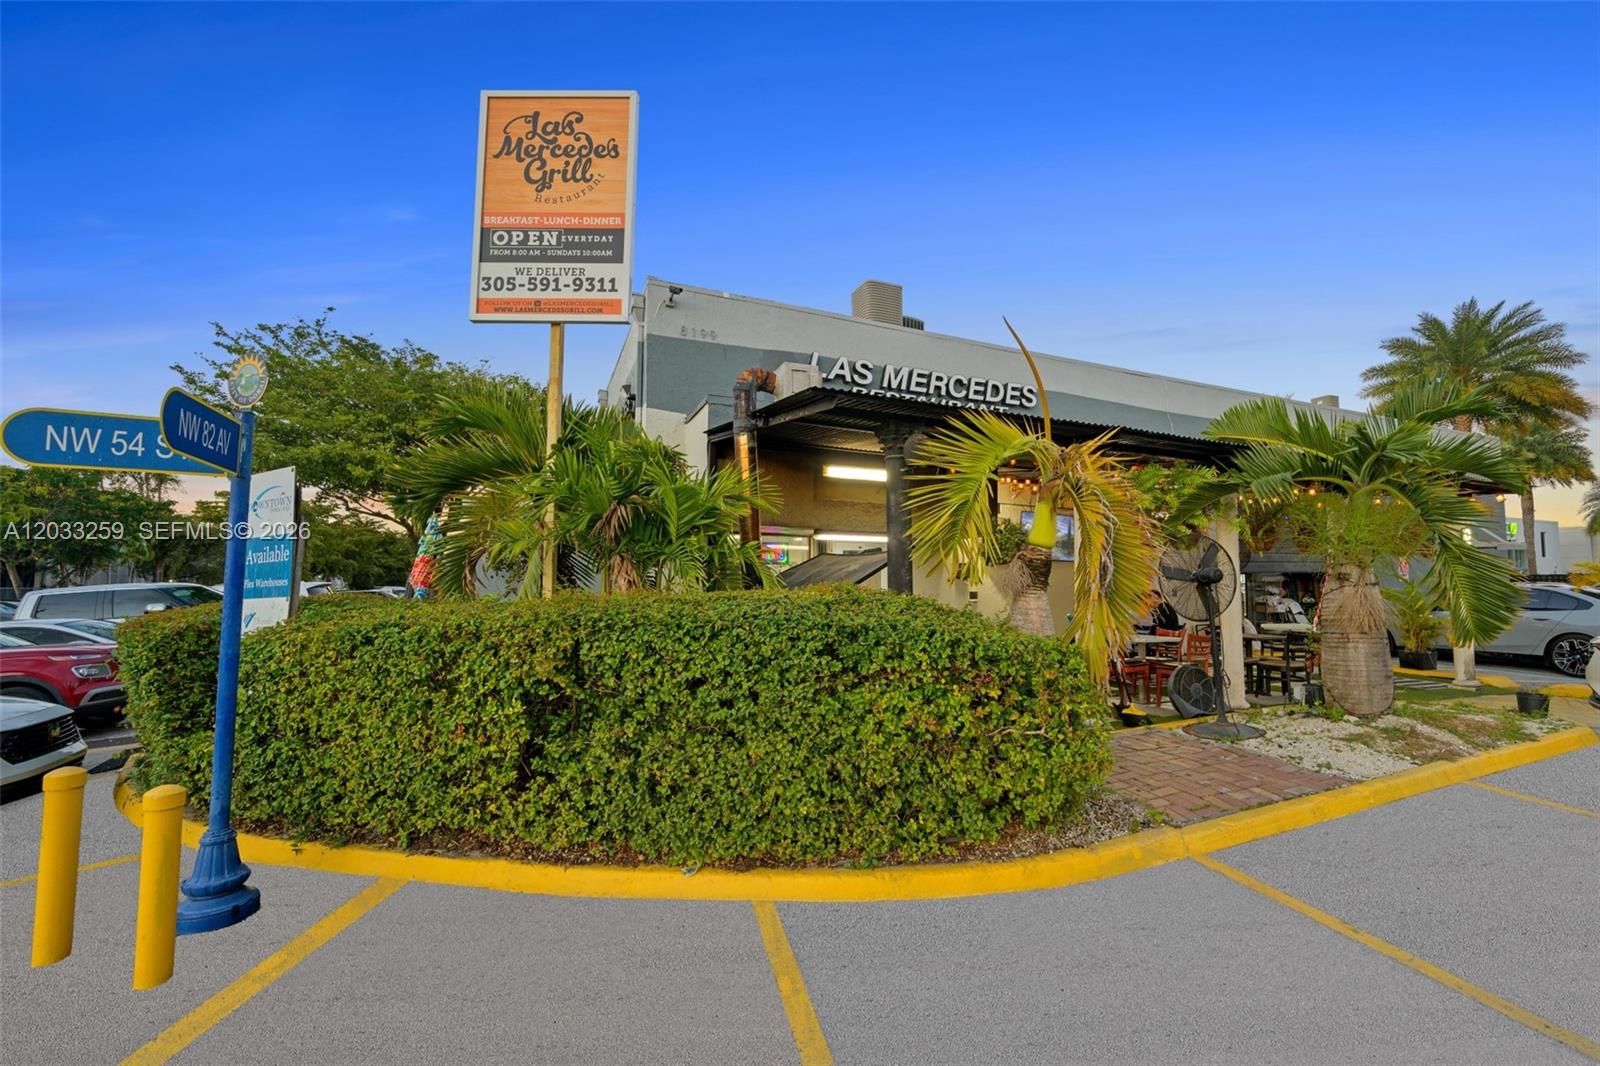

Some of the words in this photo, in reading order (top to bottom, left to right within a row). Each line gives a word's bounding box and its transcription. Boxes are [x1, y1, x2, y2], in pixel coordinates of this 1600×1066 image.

[504, 111, 583, 144] Las
[493, 132, 620, 163] Mercedes
[524, 157, 593, 192] Grill
[534, 173, 605, 205] Restaurant
[493, 231, 559, 246] OPEN
[561, 235, 614, 243] EVERYDAY
[547, 249, 581, 257] SUNDAYS
[481, 276, 619, 293] 305-591-9311
[515, 267, 533, 277] WE
[536, 267, 586, 277] DELIVER
[680, 325, 719, 341] 8199
[883, 363, 1038, 408] MERCEDES
[45, 424, 102, 454] NW
[110, 431, 145, 456] 54
[178, 407, 202, 443] NW
[202, 420, 215, 450] 82
[215, 430, 232, 456] AV
[245, 544, 290, 565] Available
[255, 577, 289, 588] Warehouses
